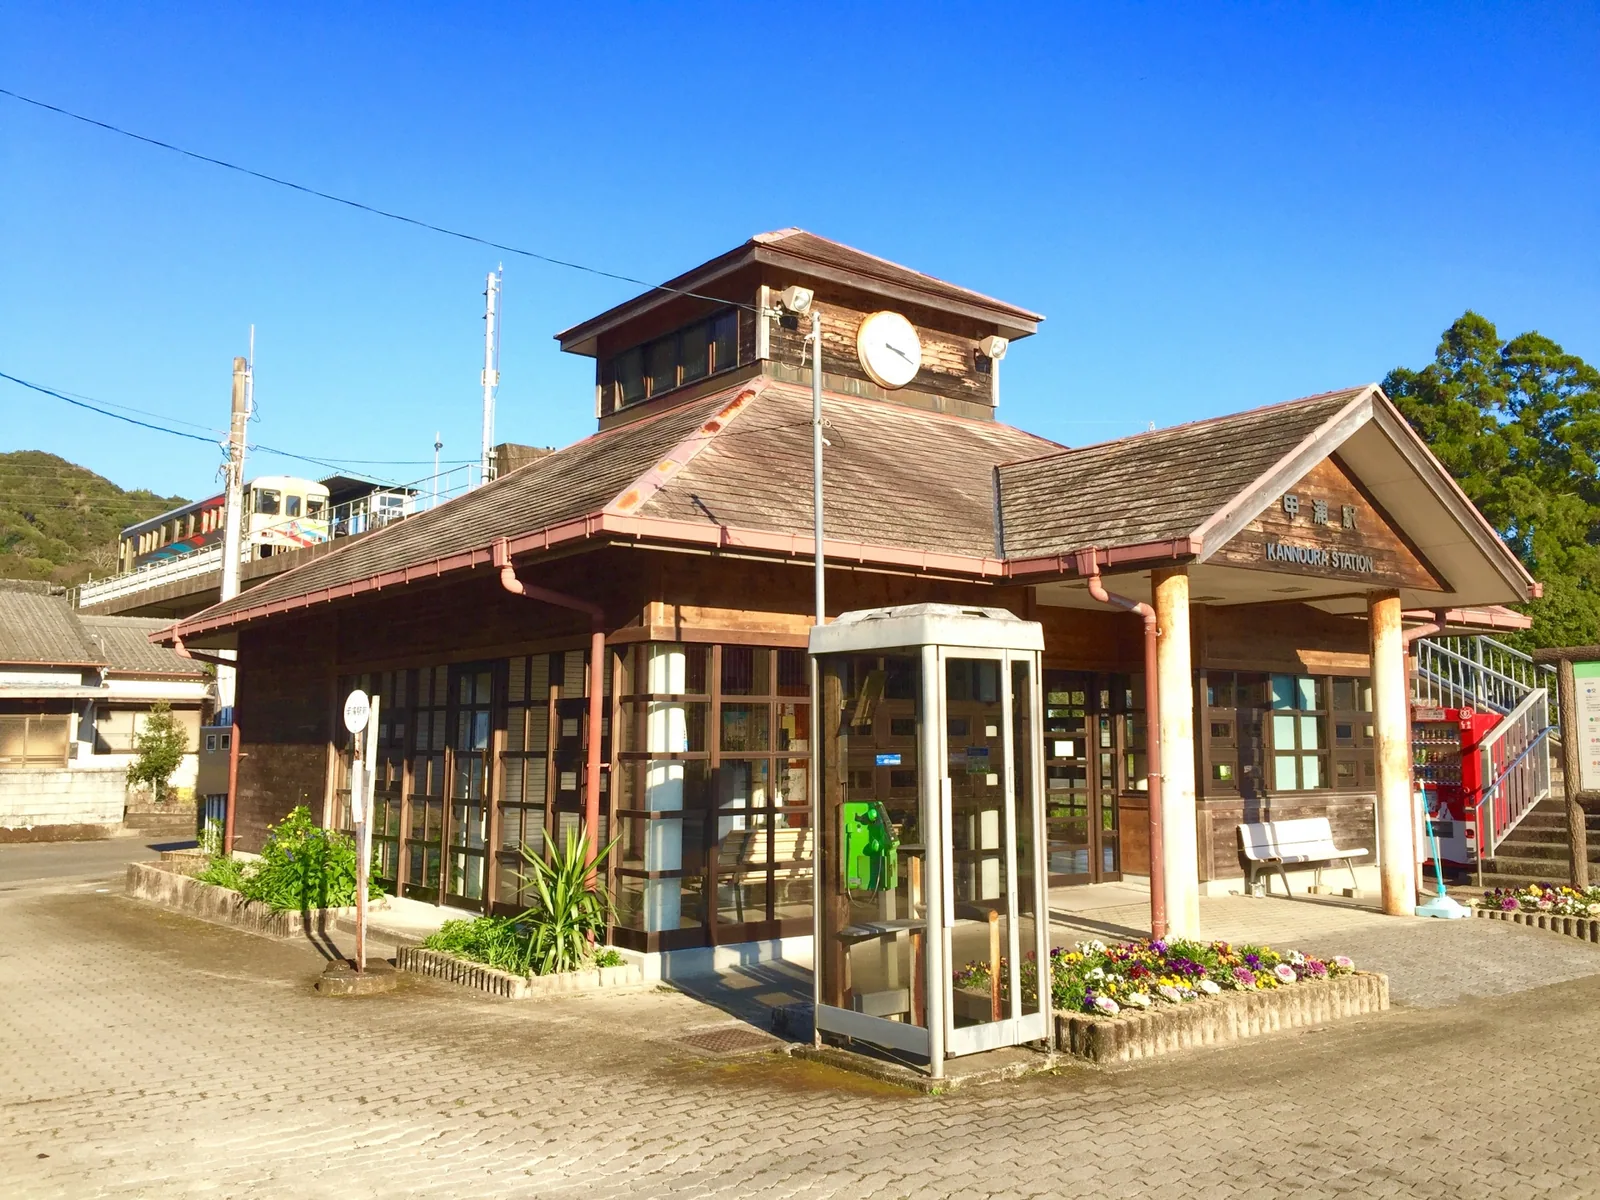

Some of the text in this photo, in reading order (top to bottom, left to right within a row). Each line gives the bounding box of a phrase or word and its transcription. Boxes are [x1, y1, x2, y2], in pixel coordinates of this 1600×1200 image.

[1283, 494, 1358, 530] 甲浦駅
[1266, 543, 1373, 573] KANNOURA STATION
